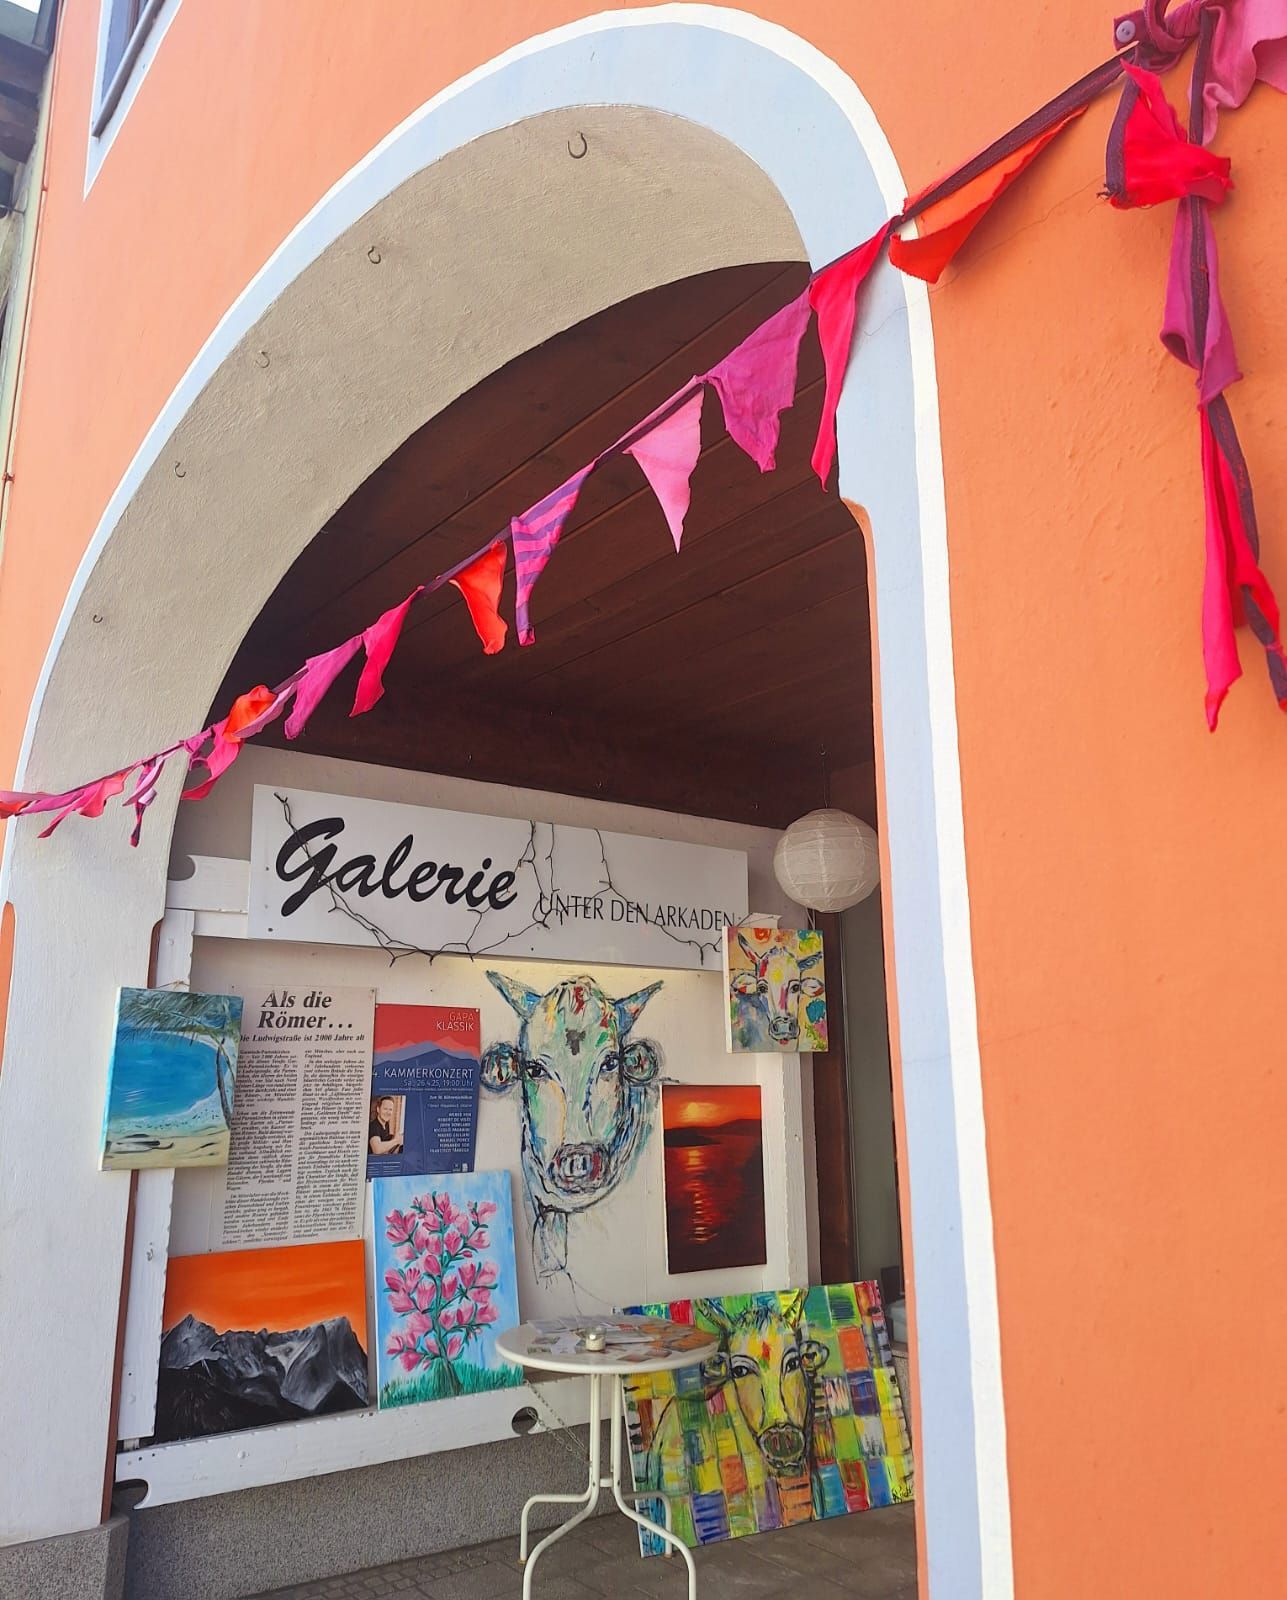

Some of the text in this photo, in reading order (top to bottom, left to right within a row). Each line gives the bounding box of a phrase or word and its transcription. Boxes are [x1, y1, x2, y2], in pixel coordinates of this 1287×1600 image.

[275, 816, 518, 917] Galerie
[539, 891, 736, 931] UNTER DEN ARKADEN
[262, 990, 333, 1008] Als die
[449, 1011, 475, 1022] GAPA
[436, 1020, 475, 1032] KLASSIK
[252, 1033, 302, 1044] Ludwigstraße
[333, 1033, 354, 1042] Jahre
[384, 1067, 475, 1079] KAMMERKONZERT
